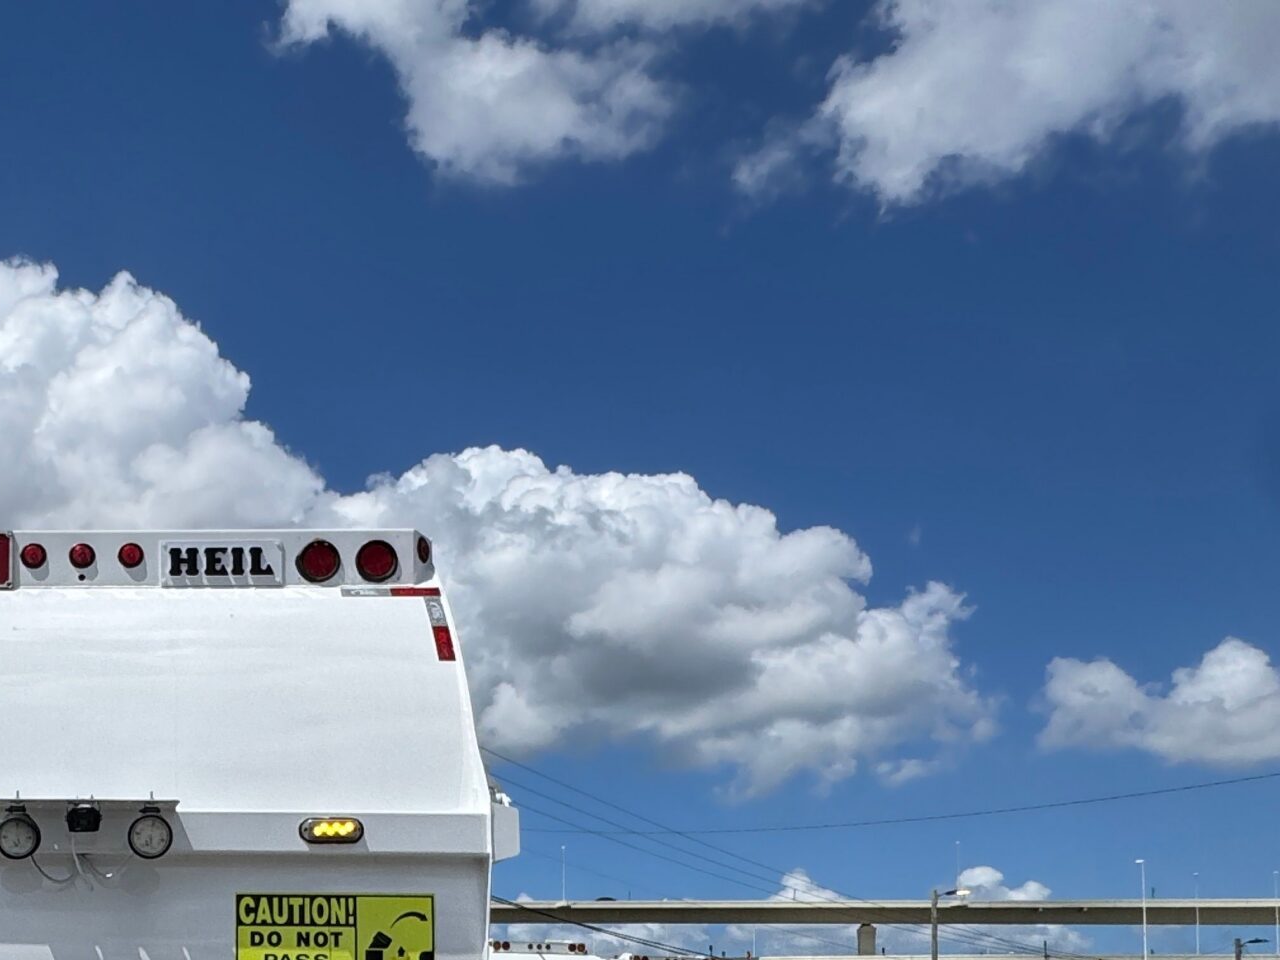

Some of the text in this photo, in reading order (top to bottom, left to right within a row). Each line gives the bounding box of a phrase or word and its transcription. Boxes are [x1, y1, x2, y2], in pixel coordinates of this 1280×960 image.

[168, 547, 274, 576] HEIL
[239, 896, 355, 925] CAUTION!
[250, 931, 343, 948] DO NOT
